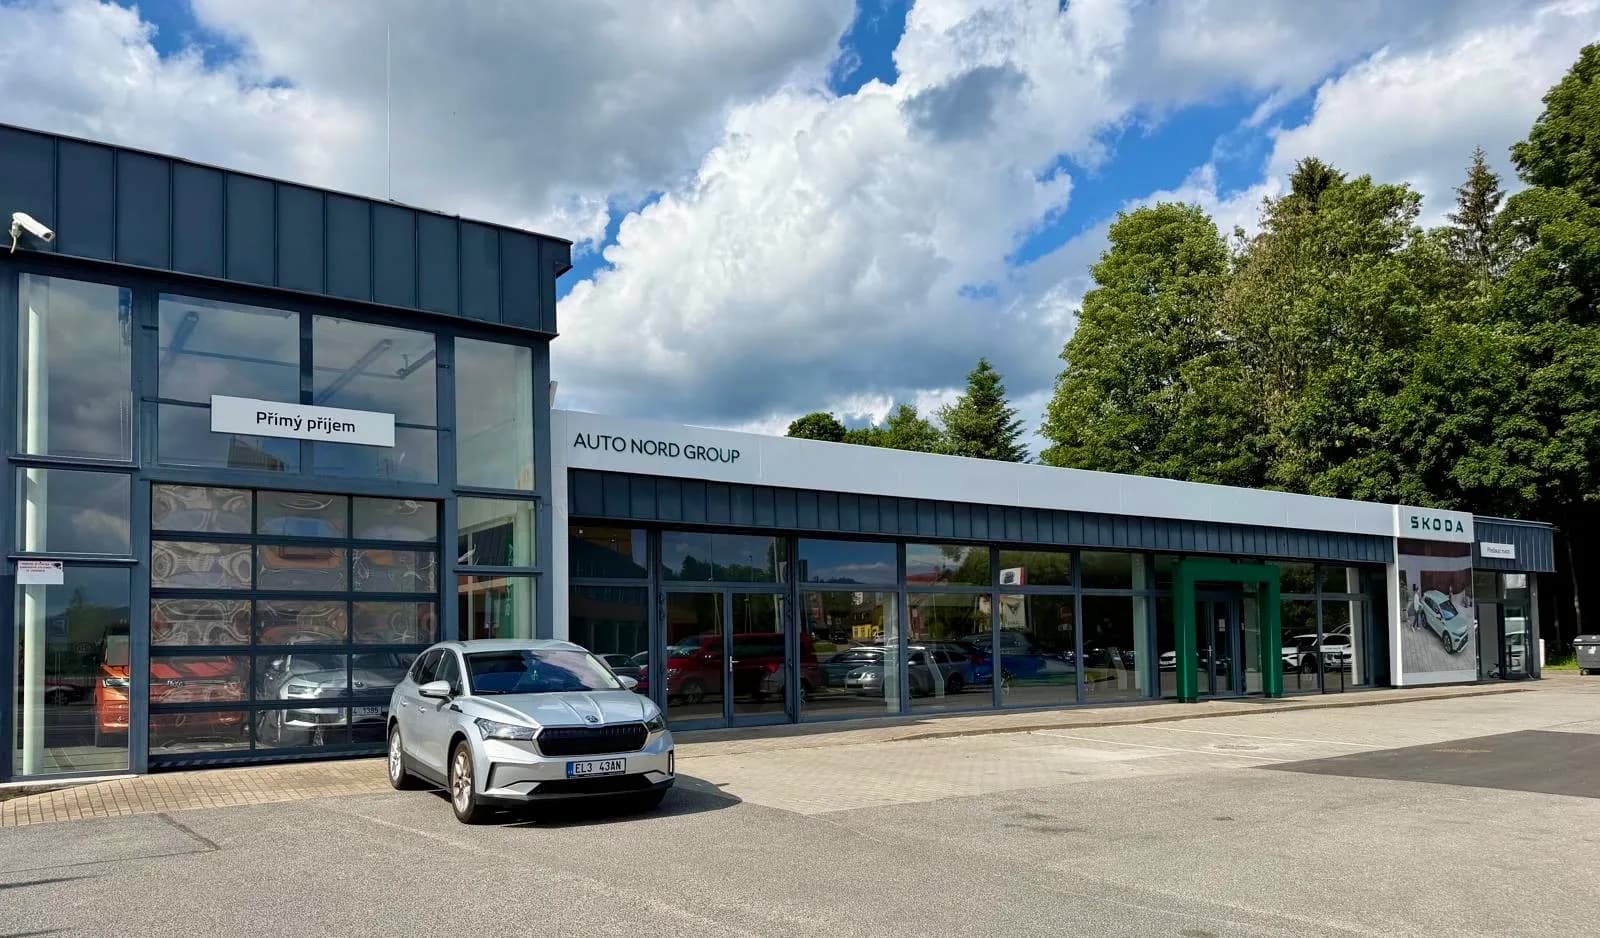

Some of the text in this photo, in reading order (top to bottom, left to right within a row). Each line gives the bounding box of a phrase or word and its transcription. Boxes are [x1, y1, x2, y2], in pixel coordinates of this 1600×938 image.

[256, 411, 356, 434] Přímý příjem
[573, 432, 740, 463] AUTO NORD GROUP
[575, 760, 622, 774] EL3 43AN
